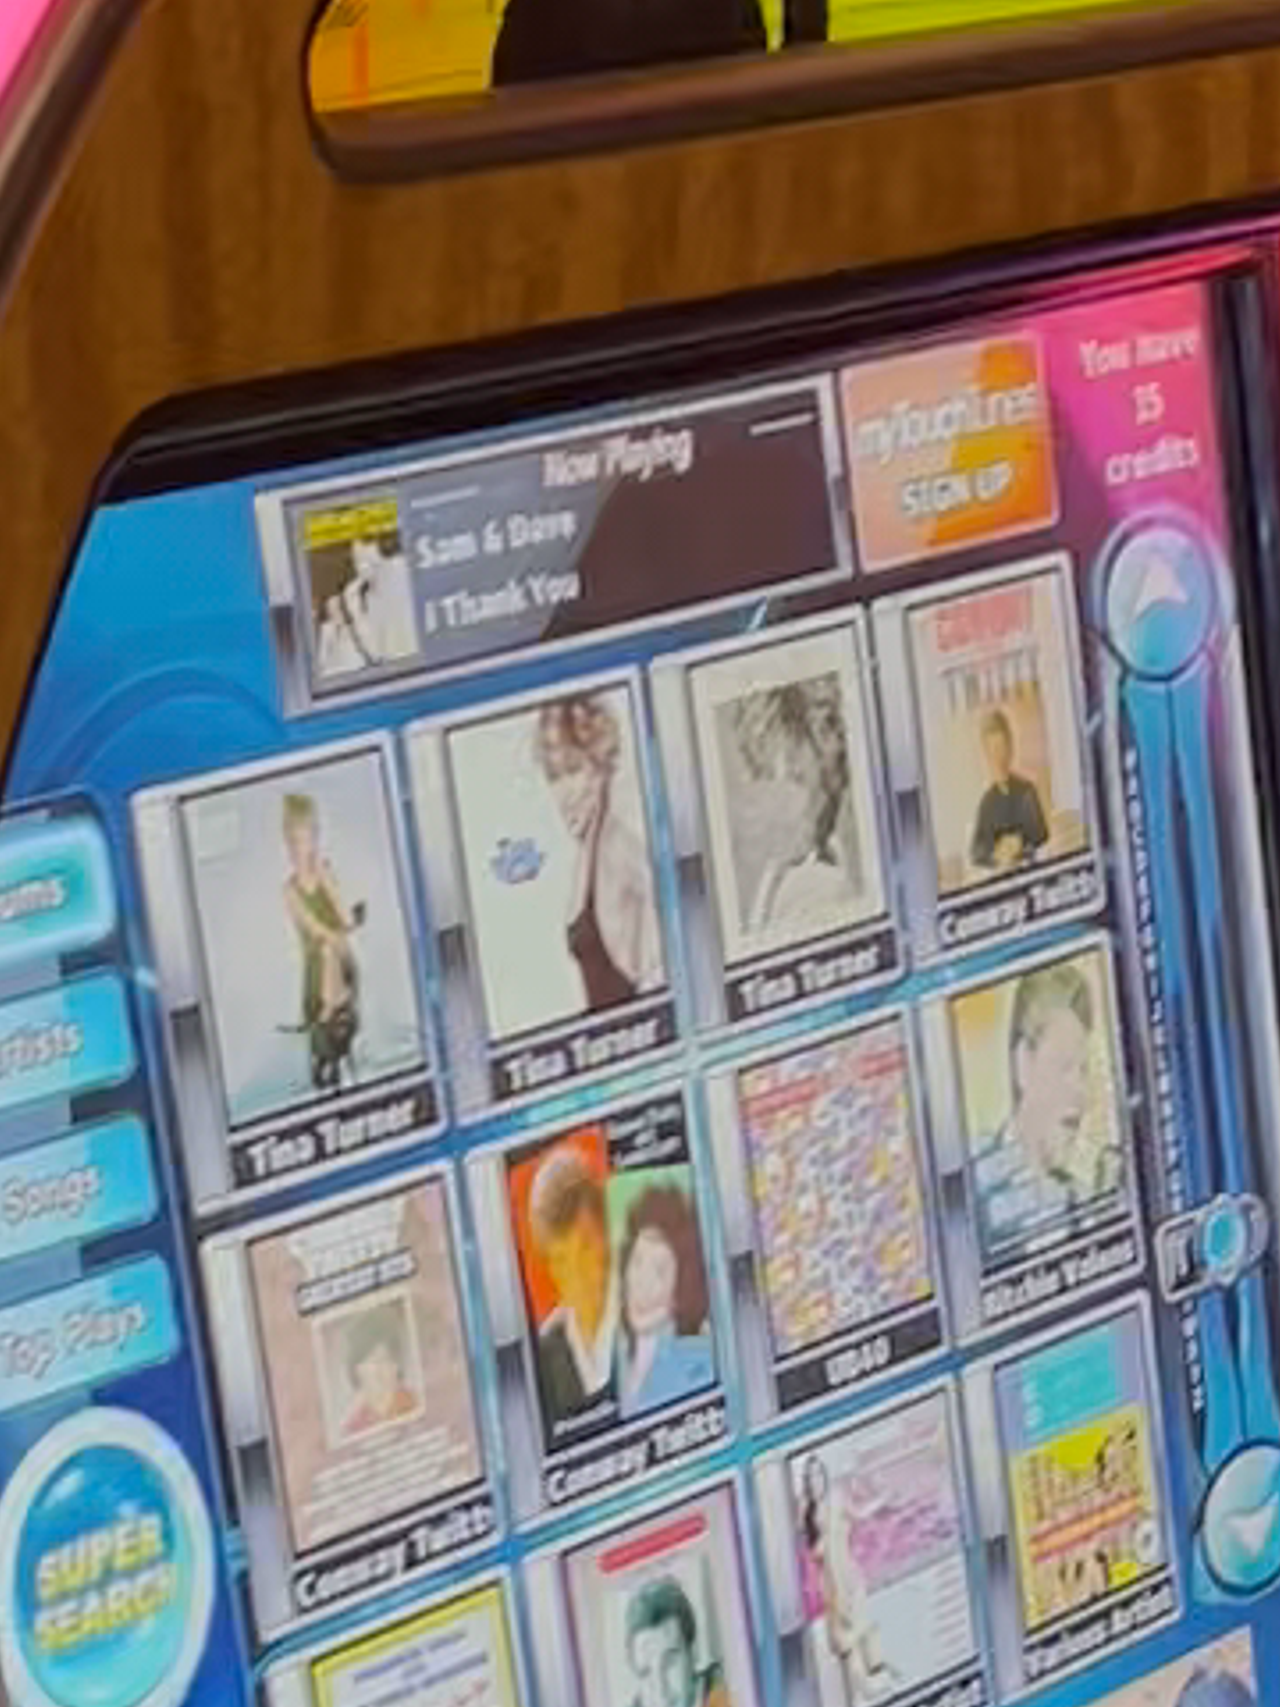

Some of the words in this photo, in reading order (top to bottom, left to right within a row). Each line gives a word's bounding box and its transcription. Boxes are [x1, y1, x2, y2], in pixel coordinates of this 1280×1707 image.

[1080, 339, 1130, 378] You
[541, 450, 599, 488] Now
[605, 428, 693, 482] Playing
[1105, 437, 1200, 487] credits
[900, 470, 970, 517] SIGN
[975, 461, 1014, 502] UP
[415, 533, 477, 570] Sam
[482, 523, 504, 554] &
[508, 509, 577, 549] Dave
[424, 602, 436, 633] I
[438, 580, 525, 628] Thank
[528, 570, 580, 606] You
[939, 896, 1026, 945] Conway
[737, 971, 796, 1011] Tina
[800, 943, 880, 993] Turner
[505, 1049, 570, 1091] Tina
[574, 1017, 660, 1073] Turner
[248, 1131, 314, 1175] Tina
[320, 1100, 417, 1156] Turner
[0, 1162, 101, 1225] Songs
[547, 1444, 646, 1500] Conway
[34, 1512, 166, 1603] SUPER
[295, 1555, 410, 1605] Conway
[32, 1563, 174, 1656] SEARCH
